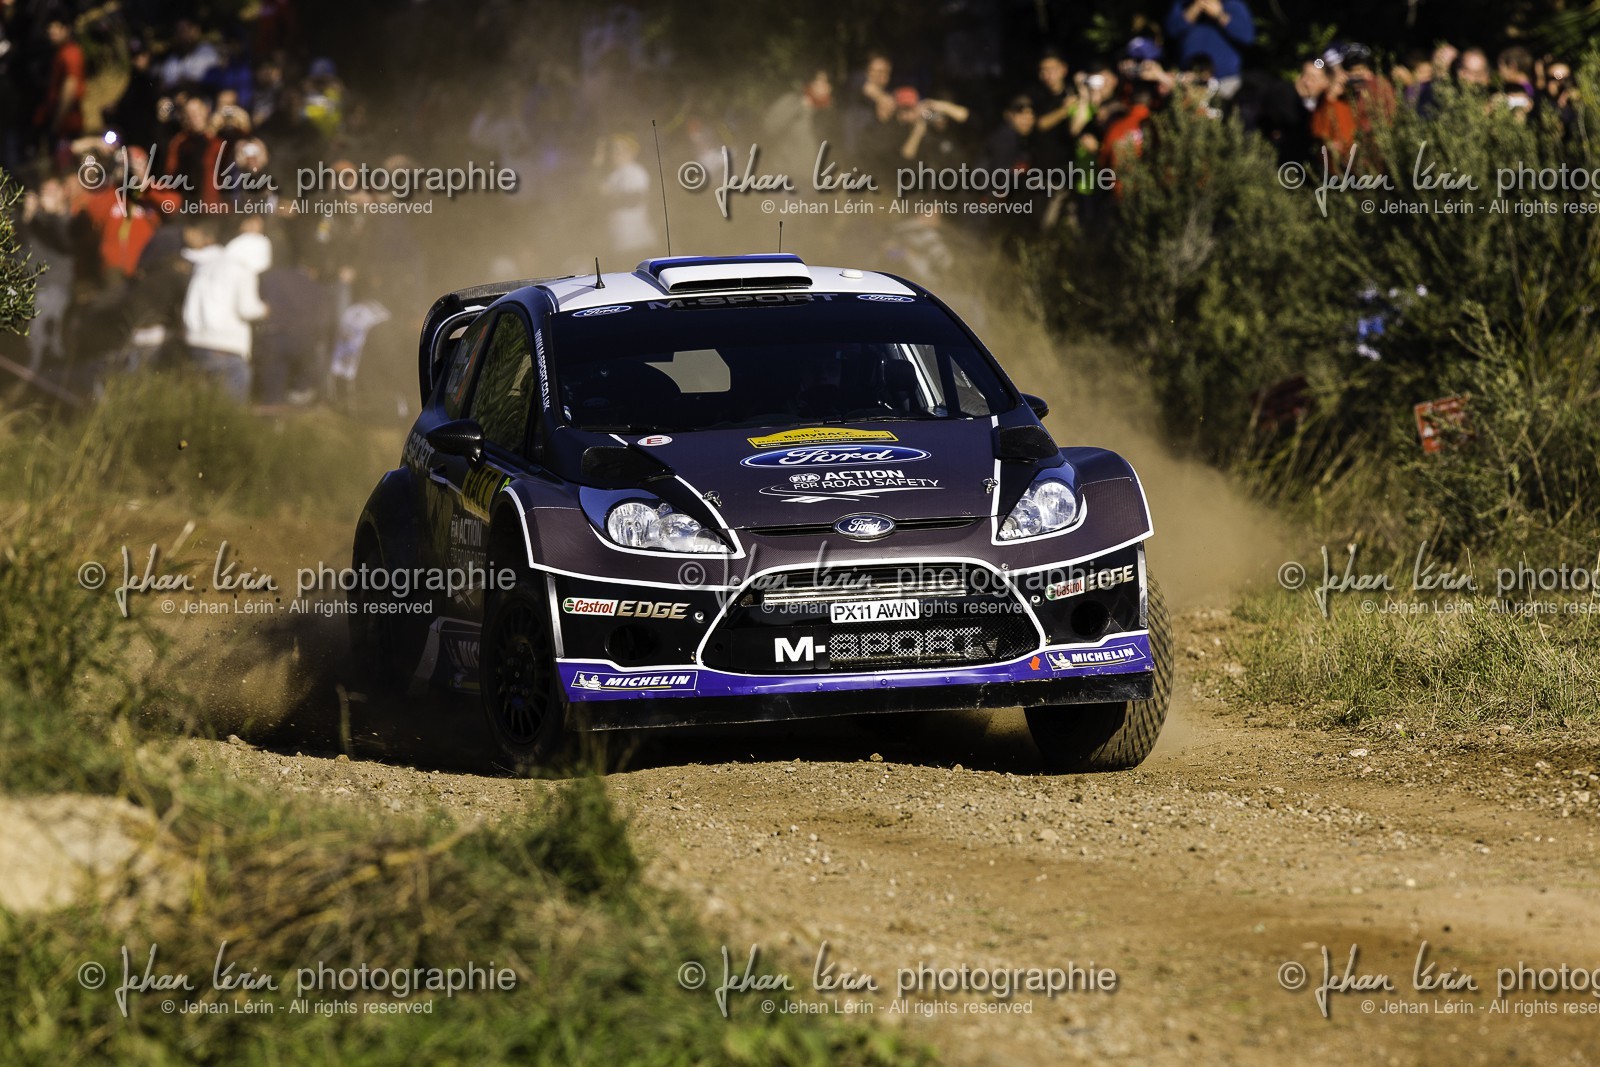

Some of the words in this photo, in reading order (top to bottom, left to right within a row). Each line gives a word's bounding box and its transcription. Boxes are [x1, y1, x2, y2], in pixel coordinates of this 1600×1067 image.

[648, 293, 839, 310] M-SPORT
[779, 447, 895, 466] Ford
[822, 479, 870, 489] ROAD
[873, 478, 940, 488] SAFETY
[824, 469, 905, 481] ACTION
[848, 518, 881, 532] Ford
[1056, 580, 1084, 597] Castrol
[1085, 564, 1136, 592] EDGE
[574, 599, 614, 614] Castrol
[616, 600, 691, 620] EDGE
[833, 604, 872, 621] PX11
[876, 602, 917, 619] AWN
[774, 626, 983, 663] M-SPORT
[1071, 647, 1135, 663] MICHELIN
[604, 675, 691, 688] MICHELIN
